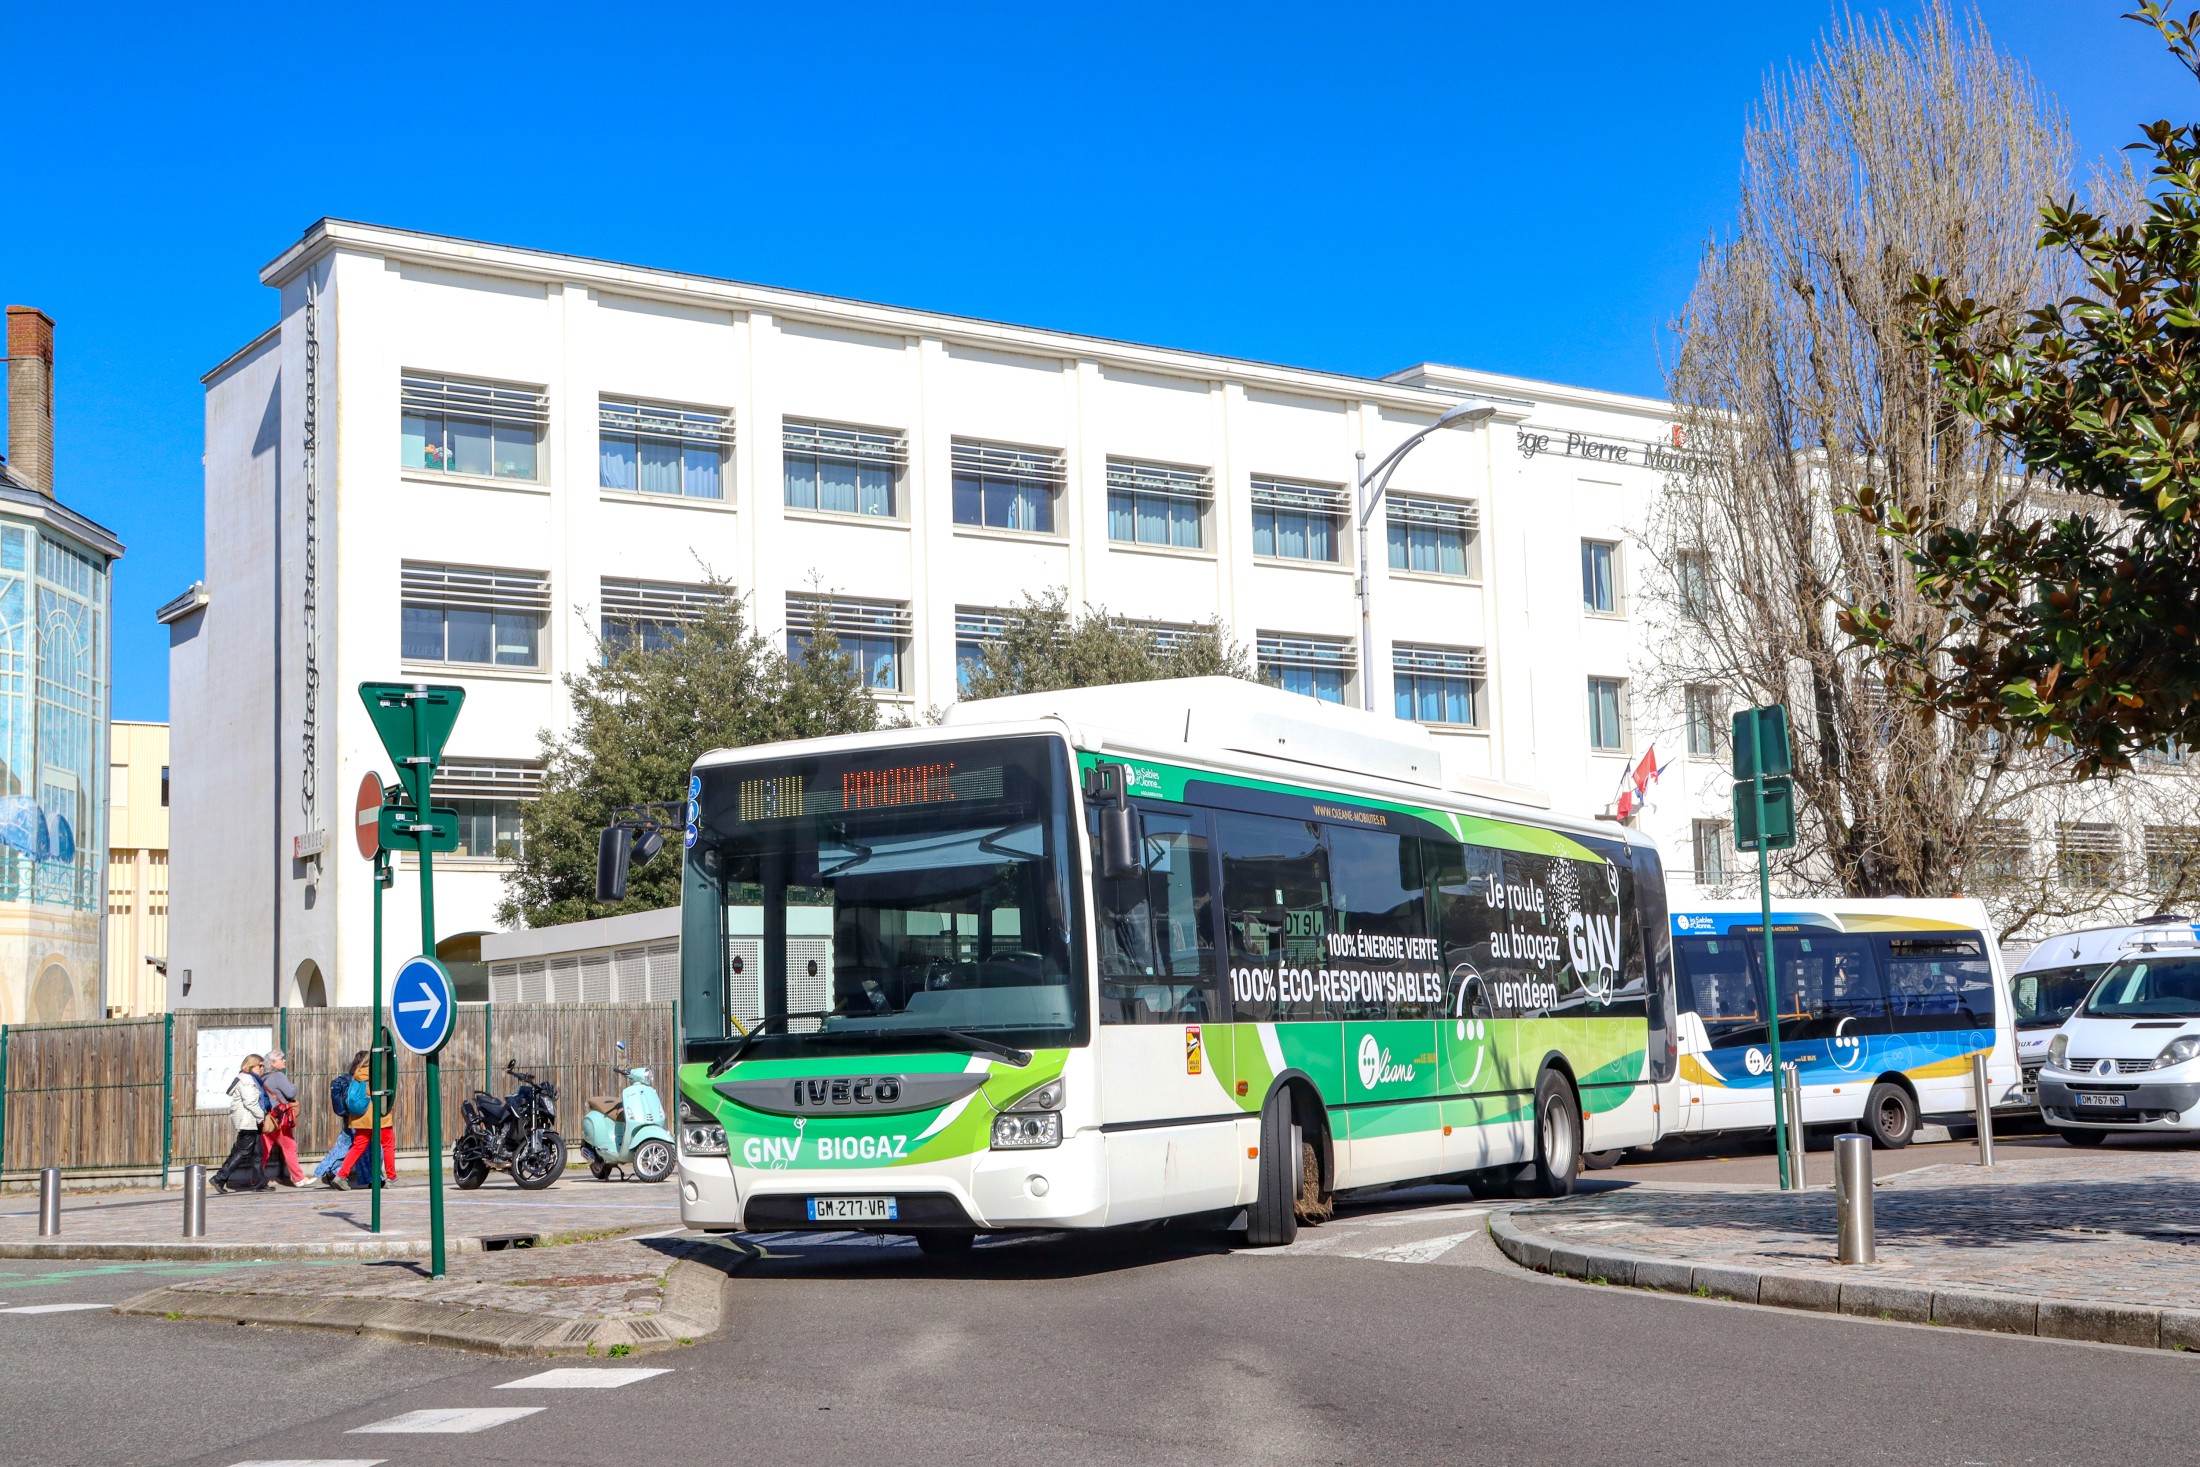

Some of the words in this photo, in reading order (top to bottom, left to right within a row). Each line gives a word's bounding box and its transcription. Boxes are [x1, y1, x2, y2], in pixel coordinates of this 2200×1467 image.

[1566, 432, 1628, 462] Pierre
[1485, 873, 1505, 909] Je
[1506, 878, 1545, 913] roule
[1327, 933, 1356, 957] 100%
[1357, 929, 1404, 959] ÉNERGIE
[1404, 938, 1439, 960] VERTE
[1490, 931, 1510, 959] au
[1511, 924, 1560, 970] biogaz
[1568, 912, 1620, 974] GNV
[1230, 968, 1276, 1002] 100%
[1278, 960, 1442, 1003] ÉCO-RESPON'SABLES
[1494, 973, 1558, 1008] vendéen
[794, 1077, 902, 1106] IVECO
[743, 1137, 802, 1164] GNV
[818, 1135, 908, 1160] BIOGAZ
